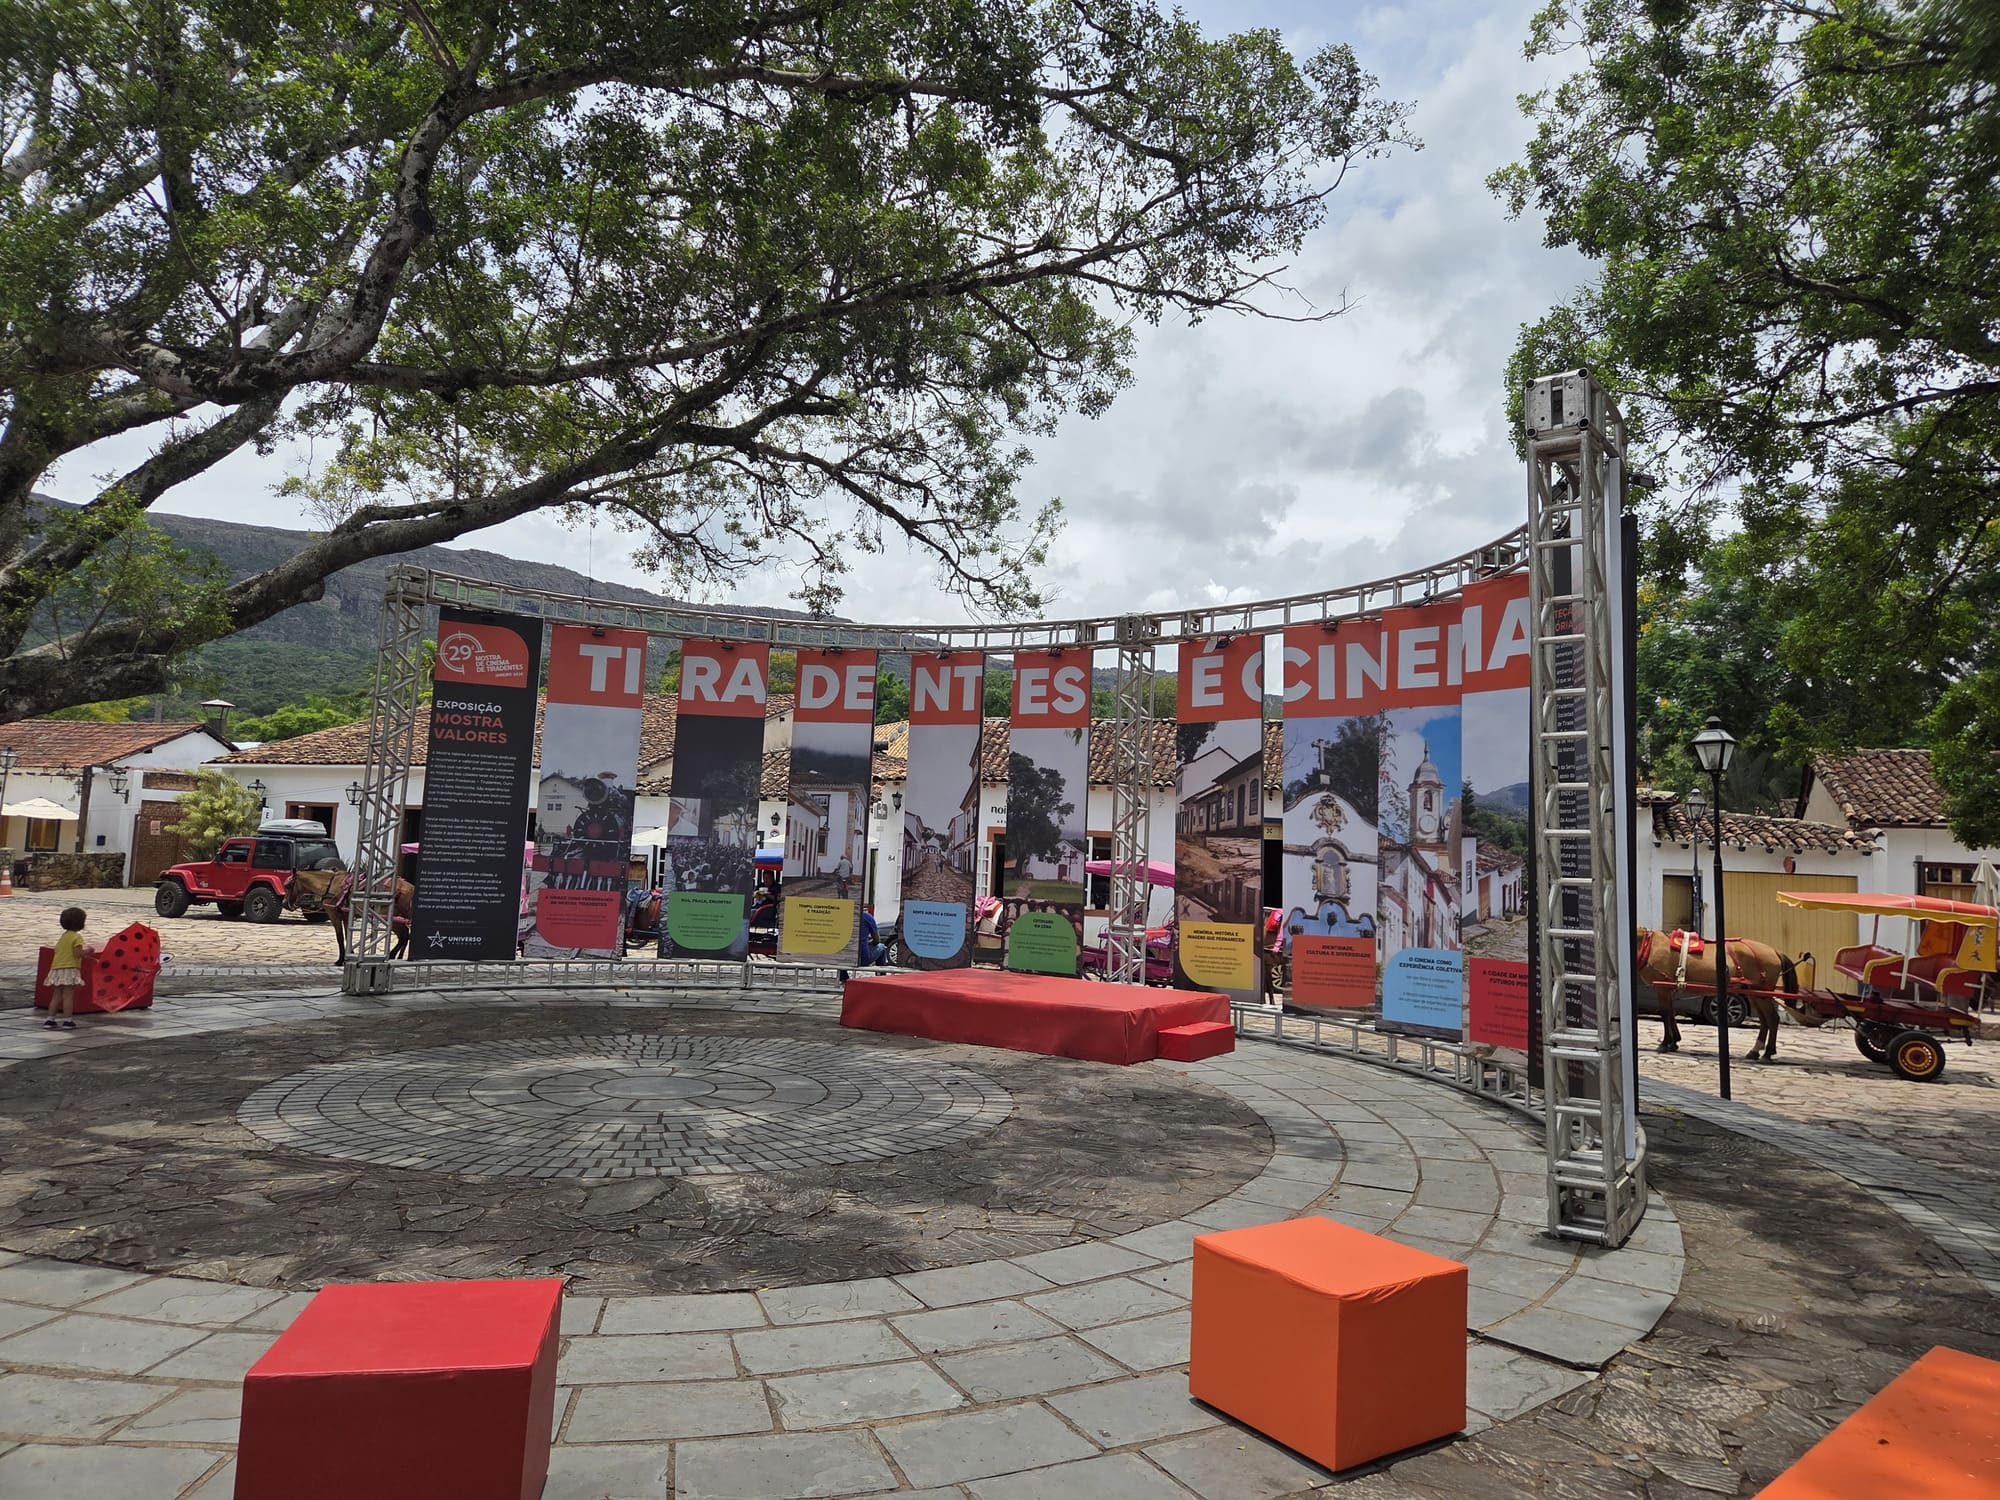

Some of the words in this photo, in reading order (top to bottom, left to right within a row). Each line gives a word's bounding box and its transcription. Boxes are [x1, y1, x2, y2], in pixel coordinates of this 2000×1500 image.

[487, 664, 524, 672] TIRADENTES
[1191, 637, 1225, 708] É
[436, 699, 502, 714] EXPOSIÇÃO
[434, 712, 504, 728] MOSTRA
[433, 727, 508, 744] VALORES
[447, 935, 482, 943] UNIVERSO
[1399, 962, 1435, 970] EXPERIÊNCIA
[1487, 970, 1508, 978] CIDADE
